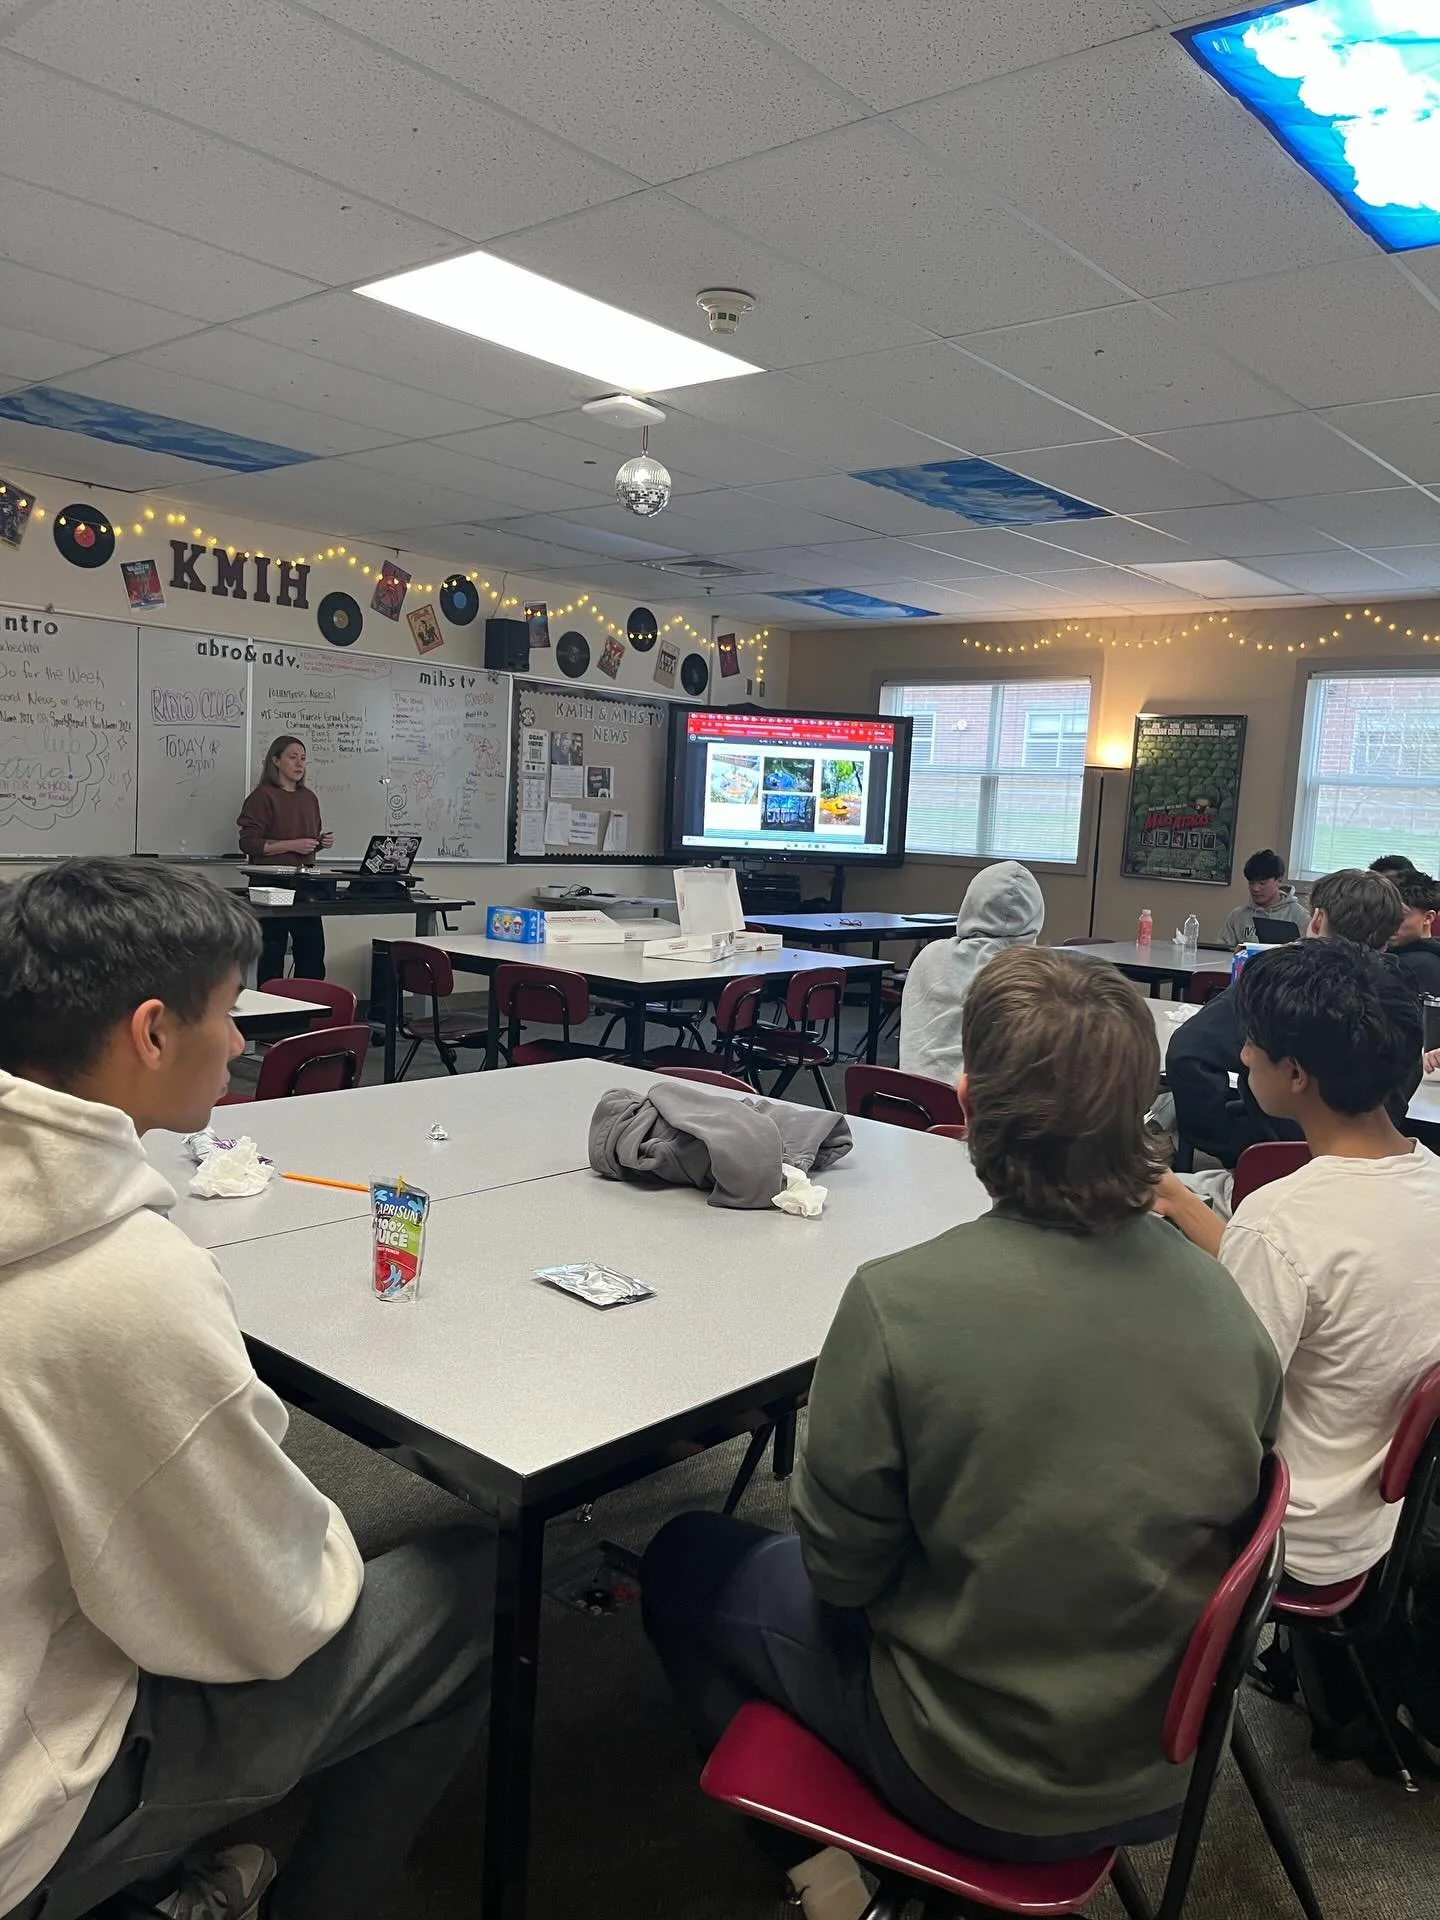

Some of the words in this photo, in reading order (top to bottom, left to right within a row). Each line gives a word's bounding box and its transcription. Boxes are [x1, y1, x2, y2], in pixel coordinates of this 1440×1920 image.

[169, 540, 311, 609] KMIH
[262, 648, 301, 670] adv.
[420, 670, 456, 688] mihs
[460, 675, 476, 688] tv
[151, 686, 199, 723] RADIO
[555, 701, 595, 721] KMIH
[598, 707, 609, 721] &
[592, 725, 630, 744] NEWS
[158, 734, 207, 759] TODAY
[377, 1217, 408, 1235] 100%
